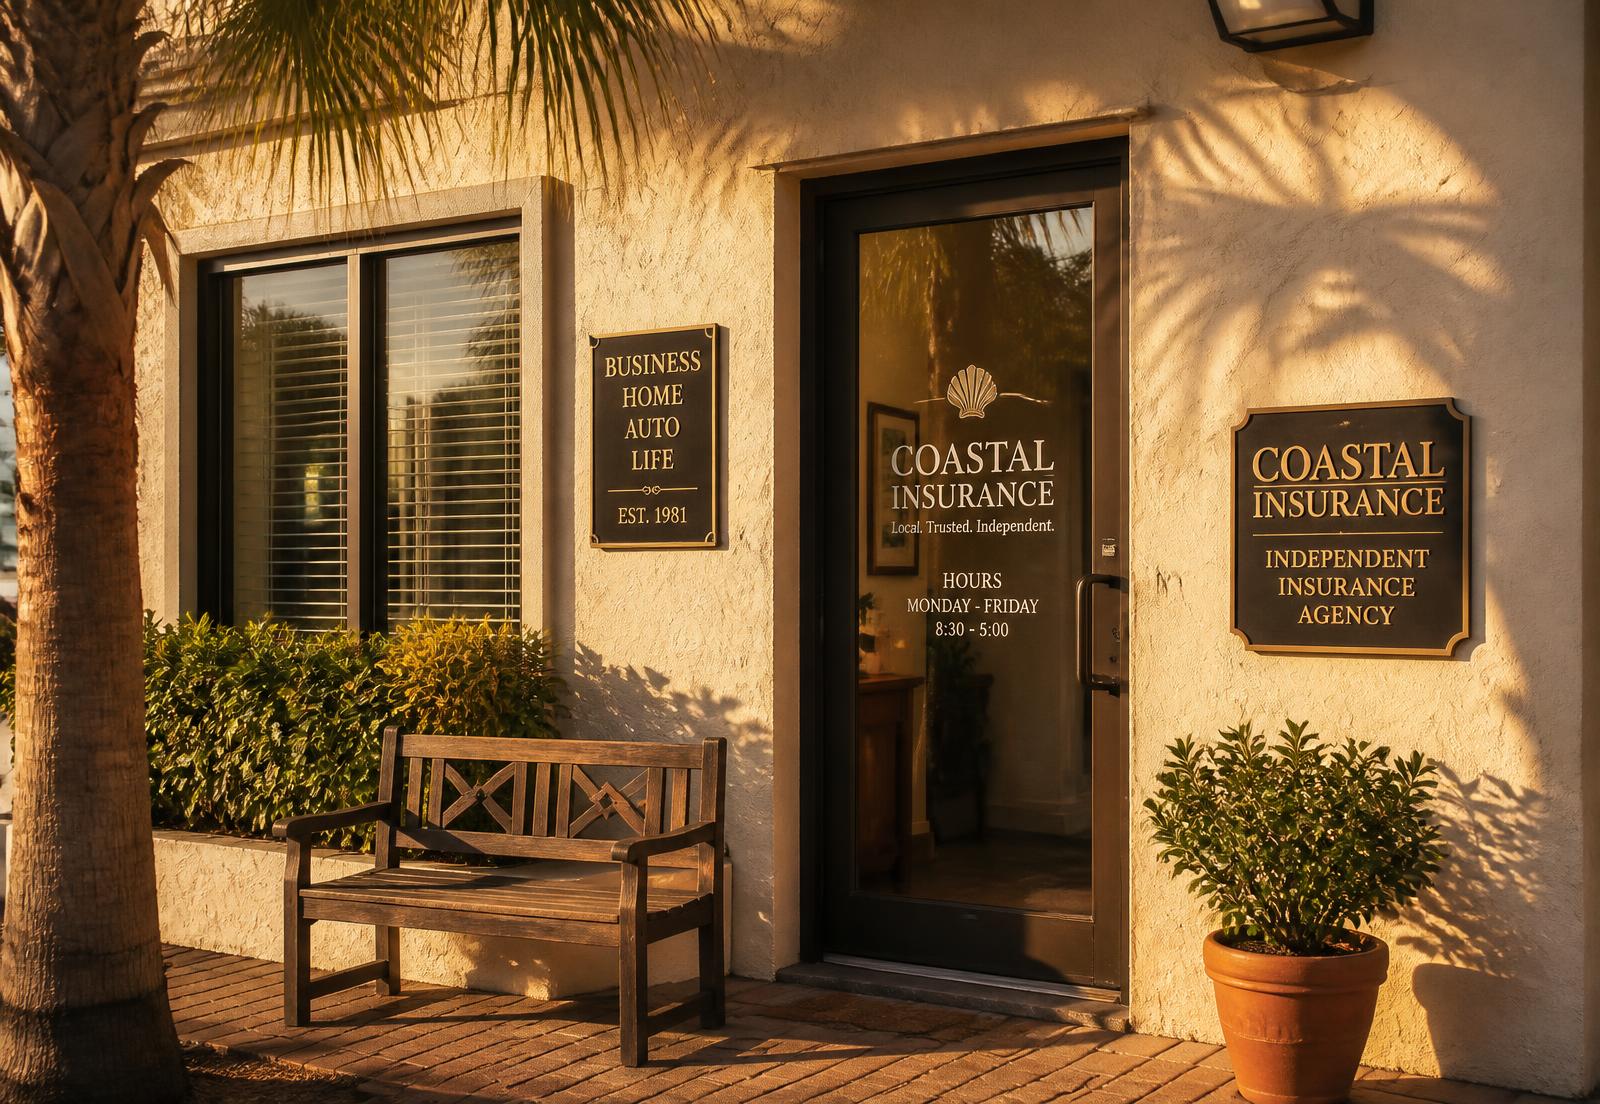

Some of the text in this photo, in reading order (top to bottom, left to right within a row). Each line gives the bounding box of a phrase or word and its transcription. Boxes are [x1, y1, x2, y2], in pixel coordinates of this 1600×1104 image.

[604, 350, 701, 378] BUSINESS
[622, 383, 684, 408] HOME
[624, 416, 681, 439] AUTO
[631, 448, 674, 471] LIFE
[891, 440, 1055, 476] COASTAL
[1252, 441, 1446, 482] COASTAL
[891, 480, 1055, 510] INSURANCE
[1252, 487, 1445, 518] INSURANCE
[618, 506, 687, 525] EST. 1981
[891, 518, 1055, 536] Local. Trusted. Independent.
[1265, 549, 1430, 569] INDEPENDENT
[943, 572, 1002, 589] HOURS
[1278, 577, 1415, 597] INSURANCE
[907, 598, 971, 613] MONDAY
[984, 598, 1039, 614] FRIDAY
[1298, 604, 1395, 625] AGENCY
[935, 622, 964, 637] 8:30
[979, 622, 1009, 637] 5:00
